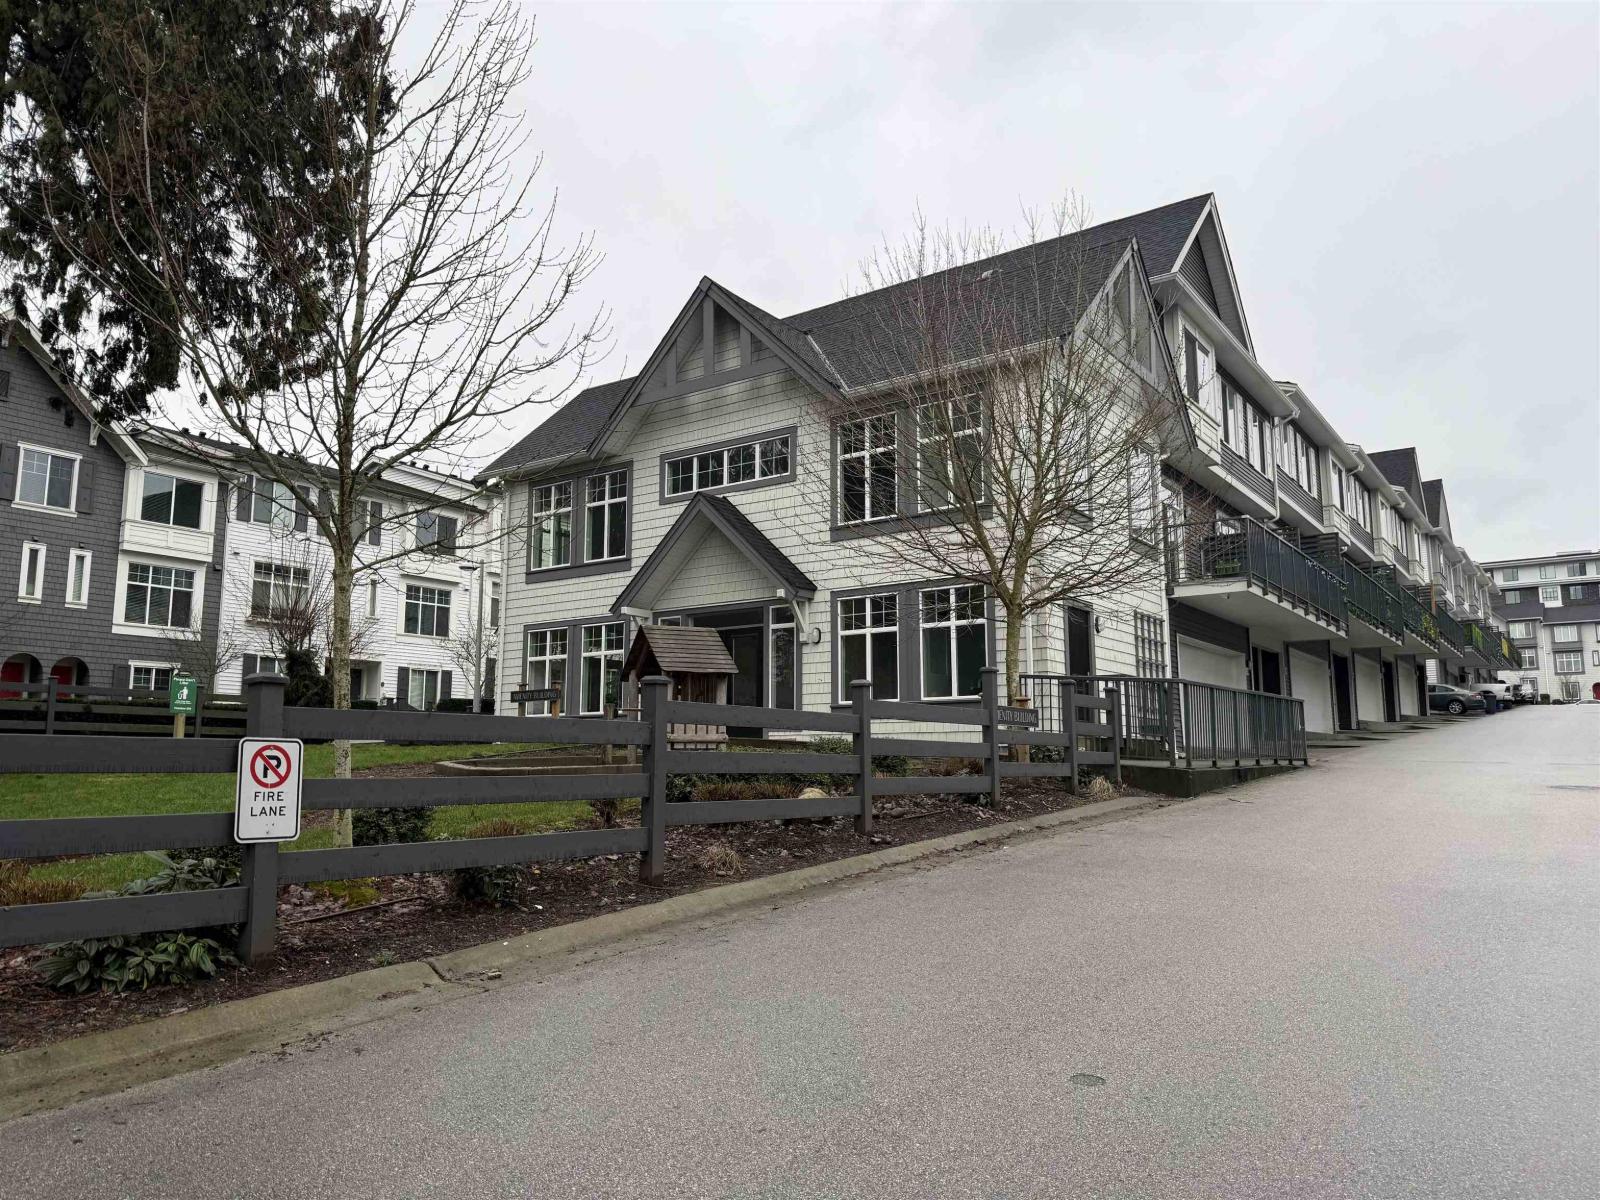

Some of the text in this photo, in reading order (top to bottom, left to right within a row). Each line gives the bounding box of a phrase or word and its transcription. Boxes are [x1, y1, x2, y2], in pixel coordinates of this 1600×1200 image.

[997, 709, 1038, 724] ENITY BUILDING
[254, 791, 285, 802] FIRE
[250, 805, 287, 817] LANE
